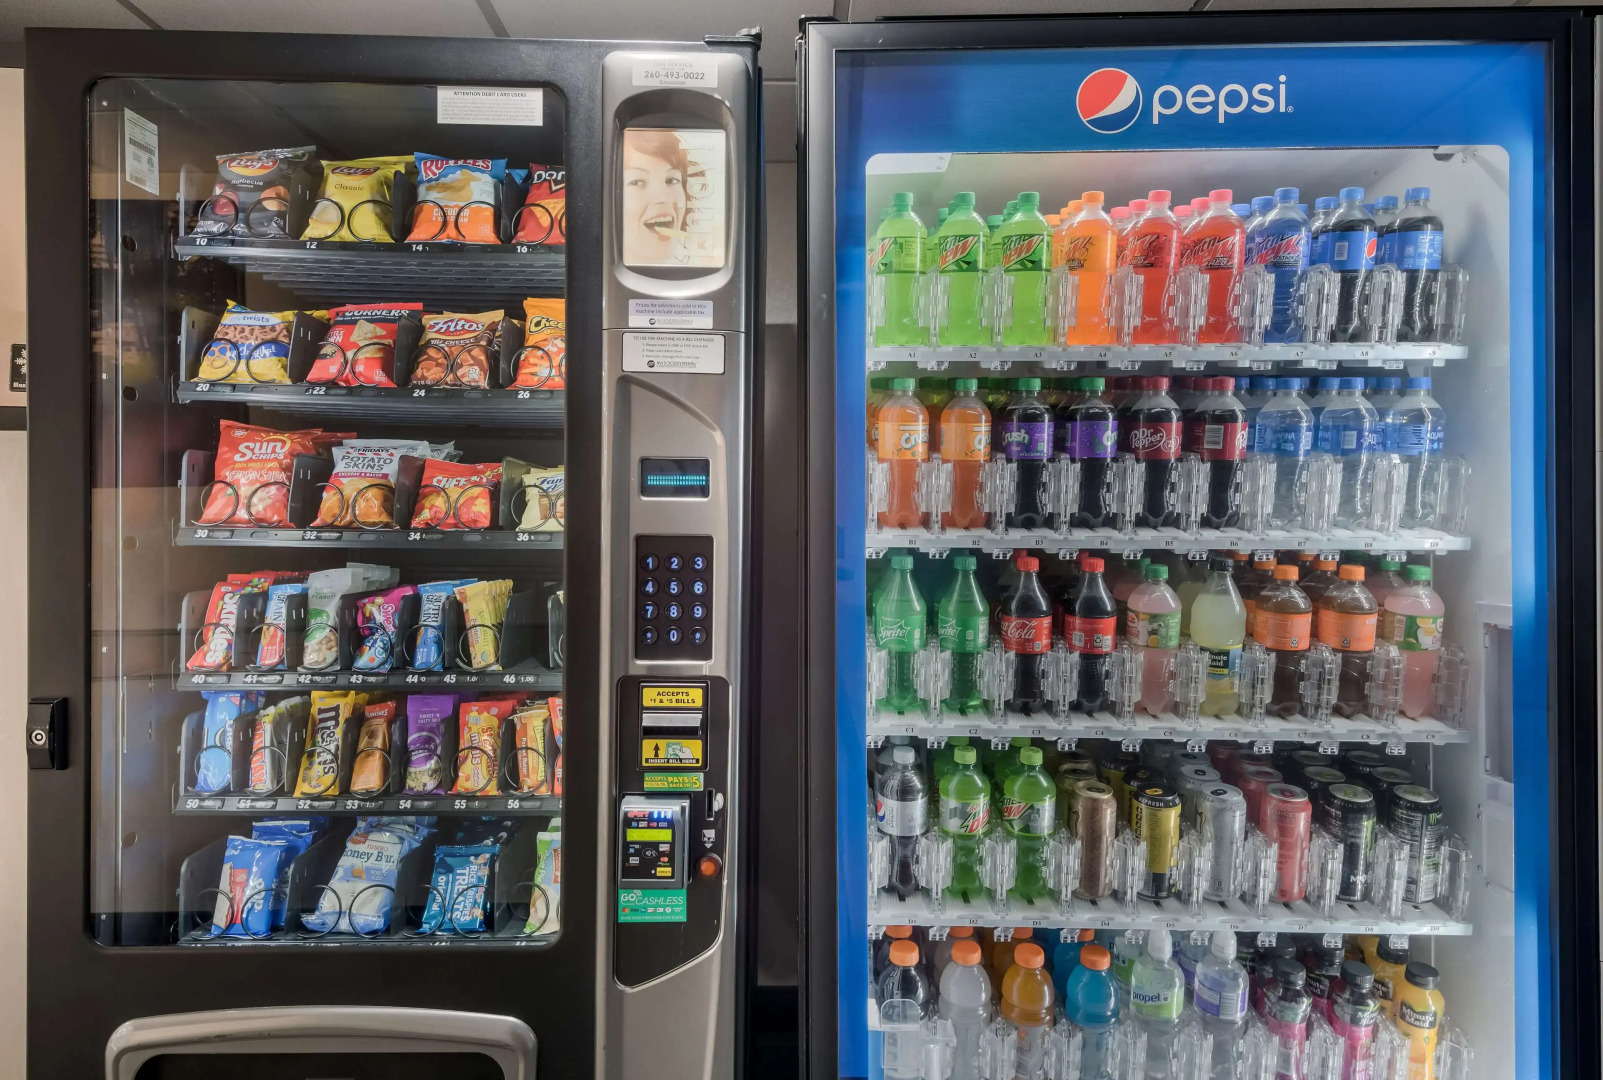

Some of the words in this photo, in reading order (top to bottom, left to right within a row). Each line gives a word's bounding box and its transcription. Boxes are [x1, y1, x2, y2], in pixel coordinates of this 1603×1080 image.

[644, 70, 705, 82] 260-493-0022
[1152, 74, 1286, 125] pepsi
[334, 183, 365, 192] Classic
[242, 314, 270, 324] twists
[427, 318, 484, 333] Fritos
[312, 387, 326, 395] 22
[1140, 428, 1153, 439] Dr
[1130, 431, 1163, 449] Pepper
[234, 441, 287, 462] Sun
[340, 455, 394, 465] POTATO
[344, 462, 385, 471] SKINS
[304, 531, 317, 539] 32
[407, 532, 420, 541] 34
[516, 533, 529, 541] 36
[646, 557, 652, 569] 1
[670, 557, 678, 569] 2
[695, 557, 702, 569] 3
[646, 582, 653, 593] 4
[670, 582, 678, 593] 5
[694, 582, 702, 594] 6
[422, 594, 433, 623] GRAIN
[432, 594, 443, 623] NUTRI
[646, 606, 653, 618] 7
[670, 606, 677, 618] 8
[694, 606, 702, 618] 9
[670, 630, 677, 641] 0
[878, 626, 906, 639] Sprite
[191, 674, 205, 683] 40
[244, 675, 258, 683] 41
[297, 674, 311, 683] 42
[350, 675, 362, 683] 43
[406, 675, 418, 683] 44
[443, 675, 456, 683] 45
[503, 675, 516, 683] 46
[186, 799, 199, 808] 50
[298, 799, 310, 808] 52
[346, 800, 358, 809] 53
[399, 800, 412, 809] 54
[454, 800, 466, 808] 55
[507, 800, 520, 808] 56
[1138, 796, 1165, 807] REFRESH
[469, 865, 478, 883] RICE
[432, 874, 447, 911] Original
[453, 866, 469, 919] TREATS
[461, 884, 474, 922] KRISPIES
[621, 893, 636, 901] GO
[635, 897, 684, 905] CASHLESS
[1133, 992, 1160, 1004] propel
[1402, 1005, 1434, 1022] Minute
[1405, 1016, 1429, 1027] Maid
